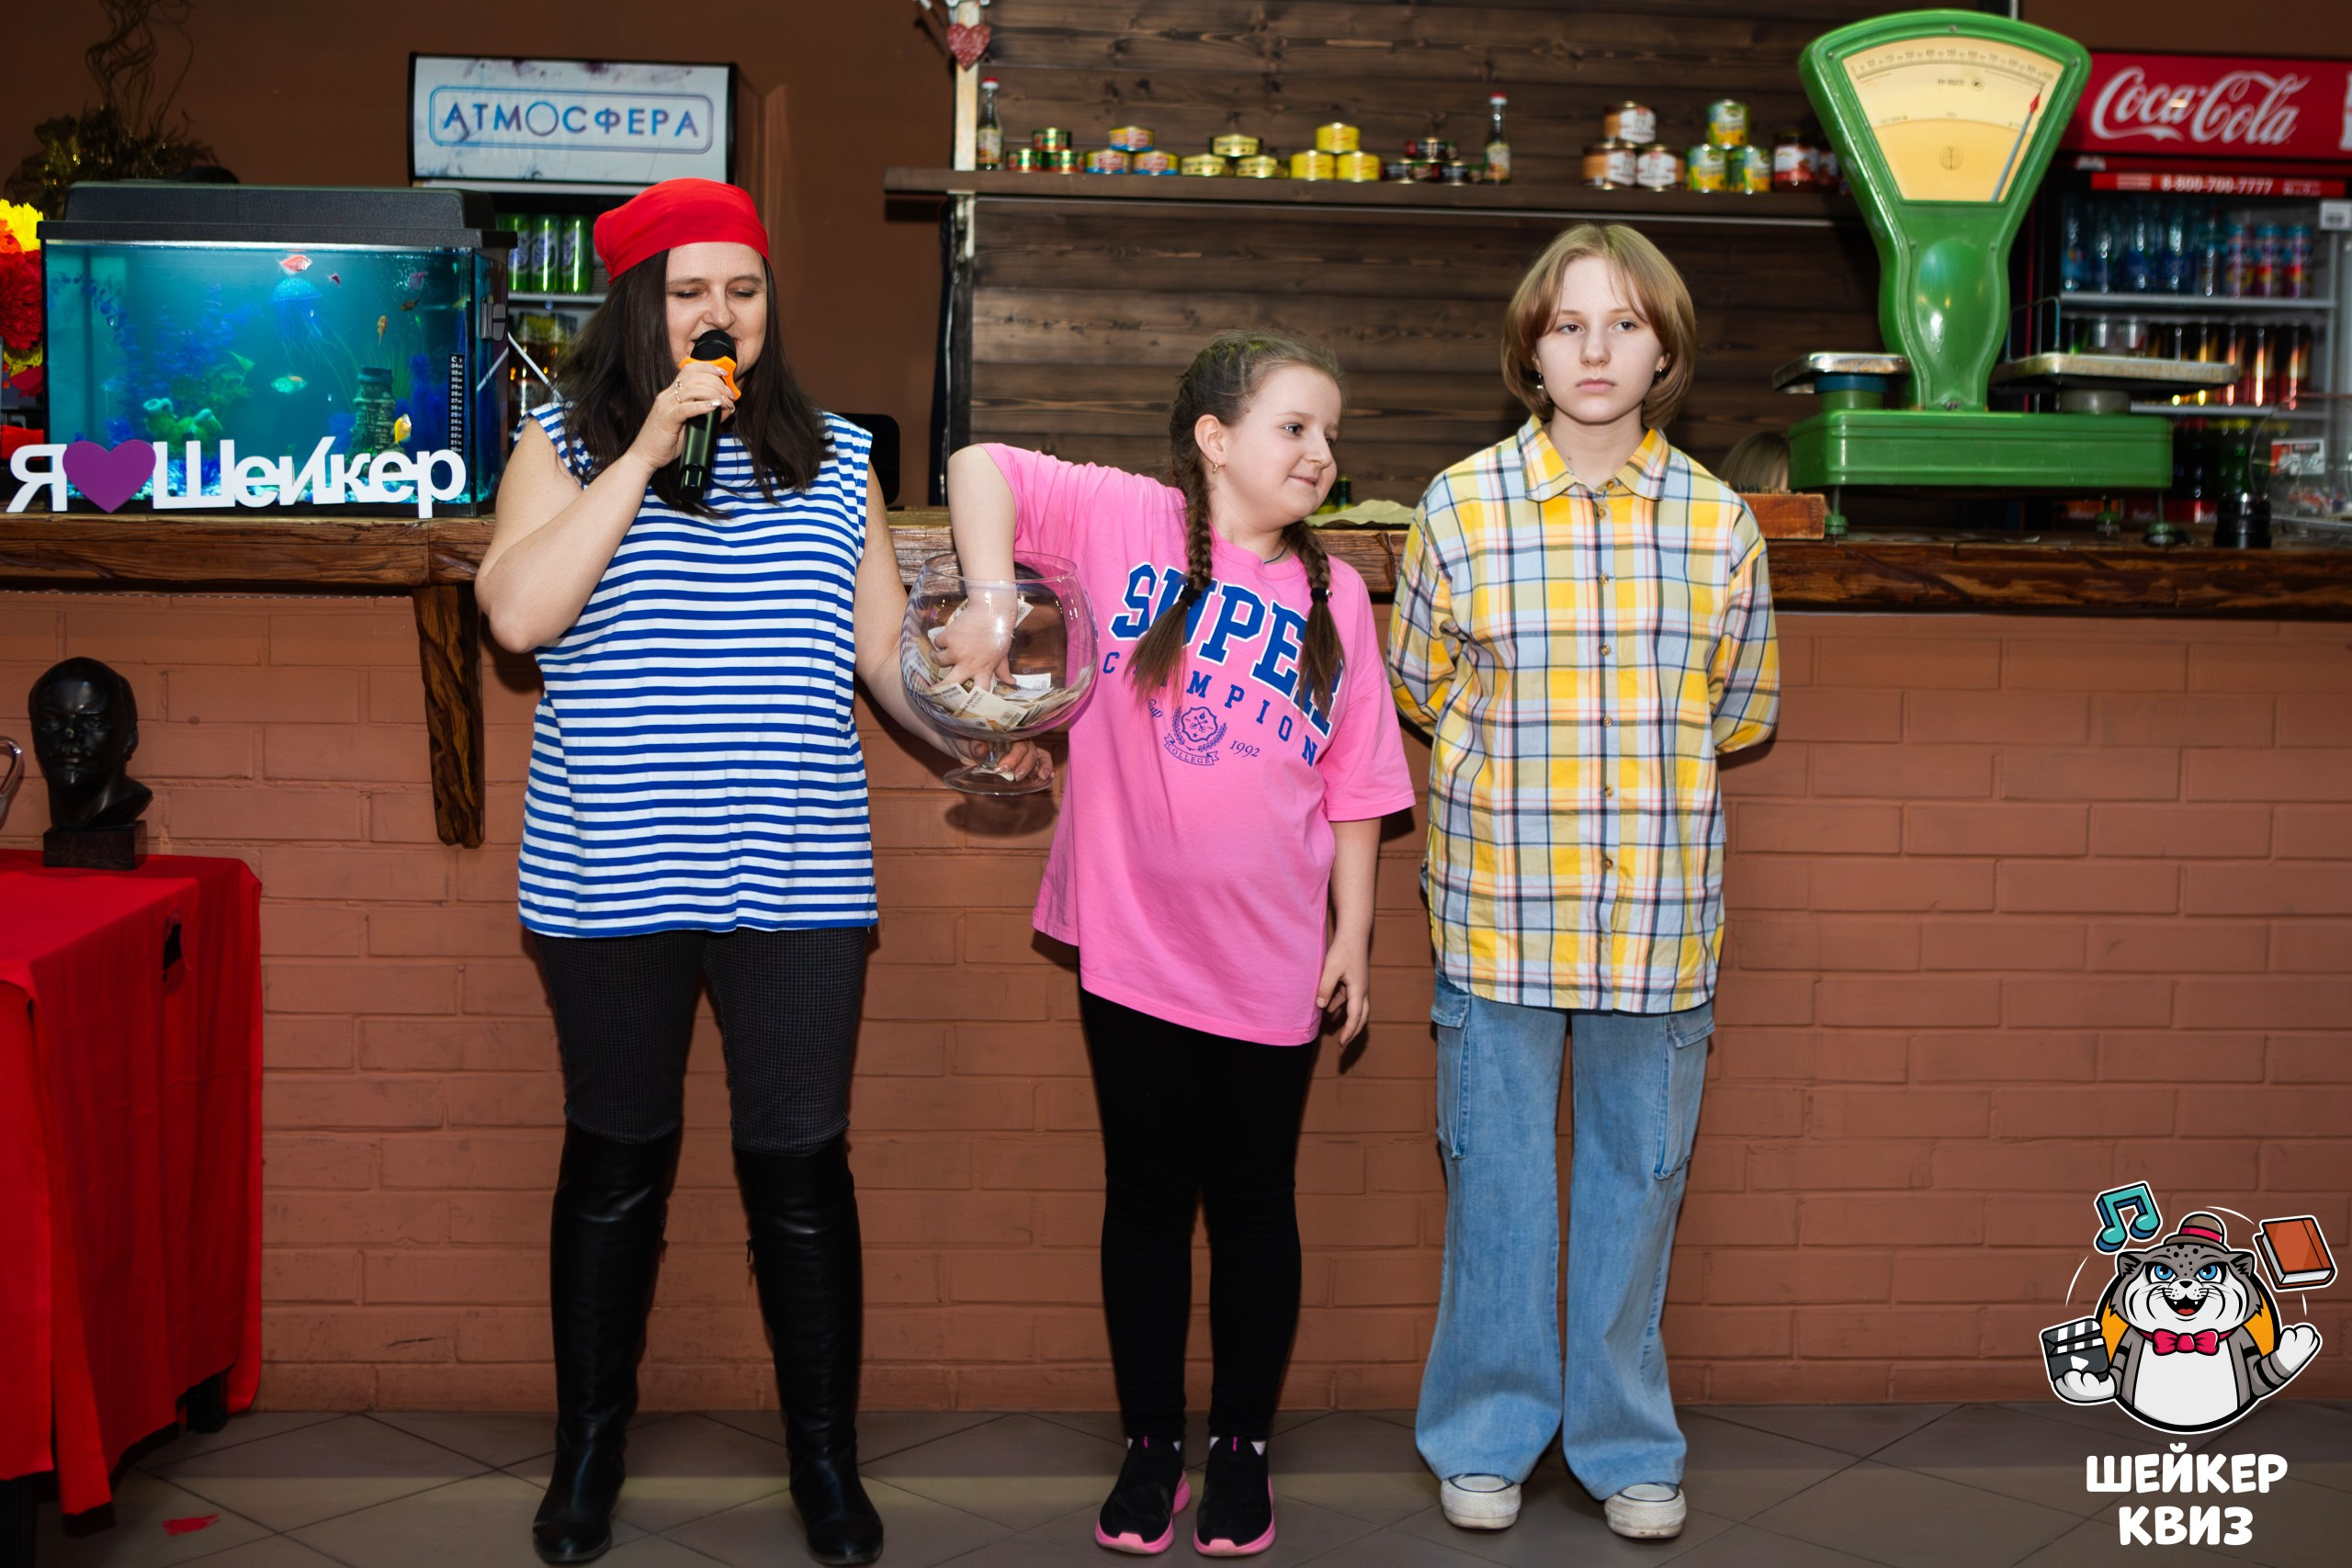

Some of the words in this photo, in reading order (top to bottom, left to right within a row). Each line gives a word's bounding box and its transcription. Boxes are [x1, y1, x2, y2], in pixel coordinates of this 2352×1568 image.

[444, 100, 700, 138] АТМОСФЕРА
[2090, 65, 2312, 145] Coca-Cola
[2161, 175, 2273, 195] 8-800-700-7777
[6, 444, 67, 513] Я
[153, 435, 467, 520] Шейкер
[1103, 651, 1318, 767] CMPION
[1167, 744, 1212, 764] COLLEGE
[1229, 740, 1261, 758] 1992
